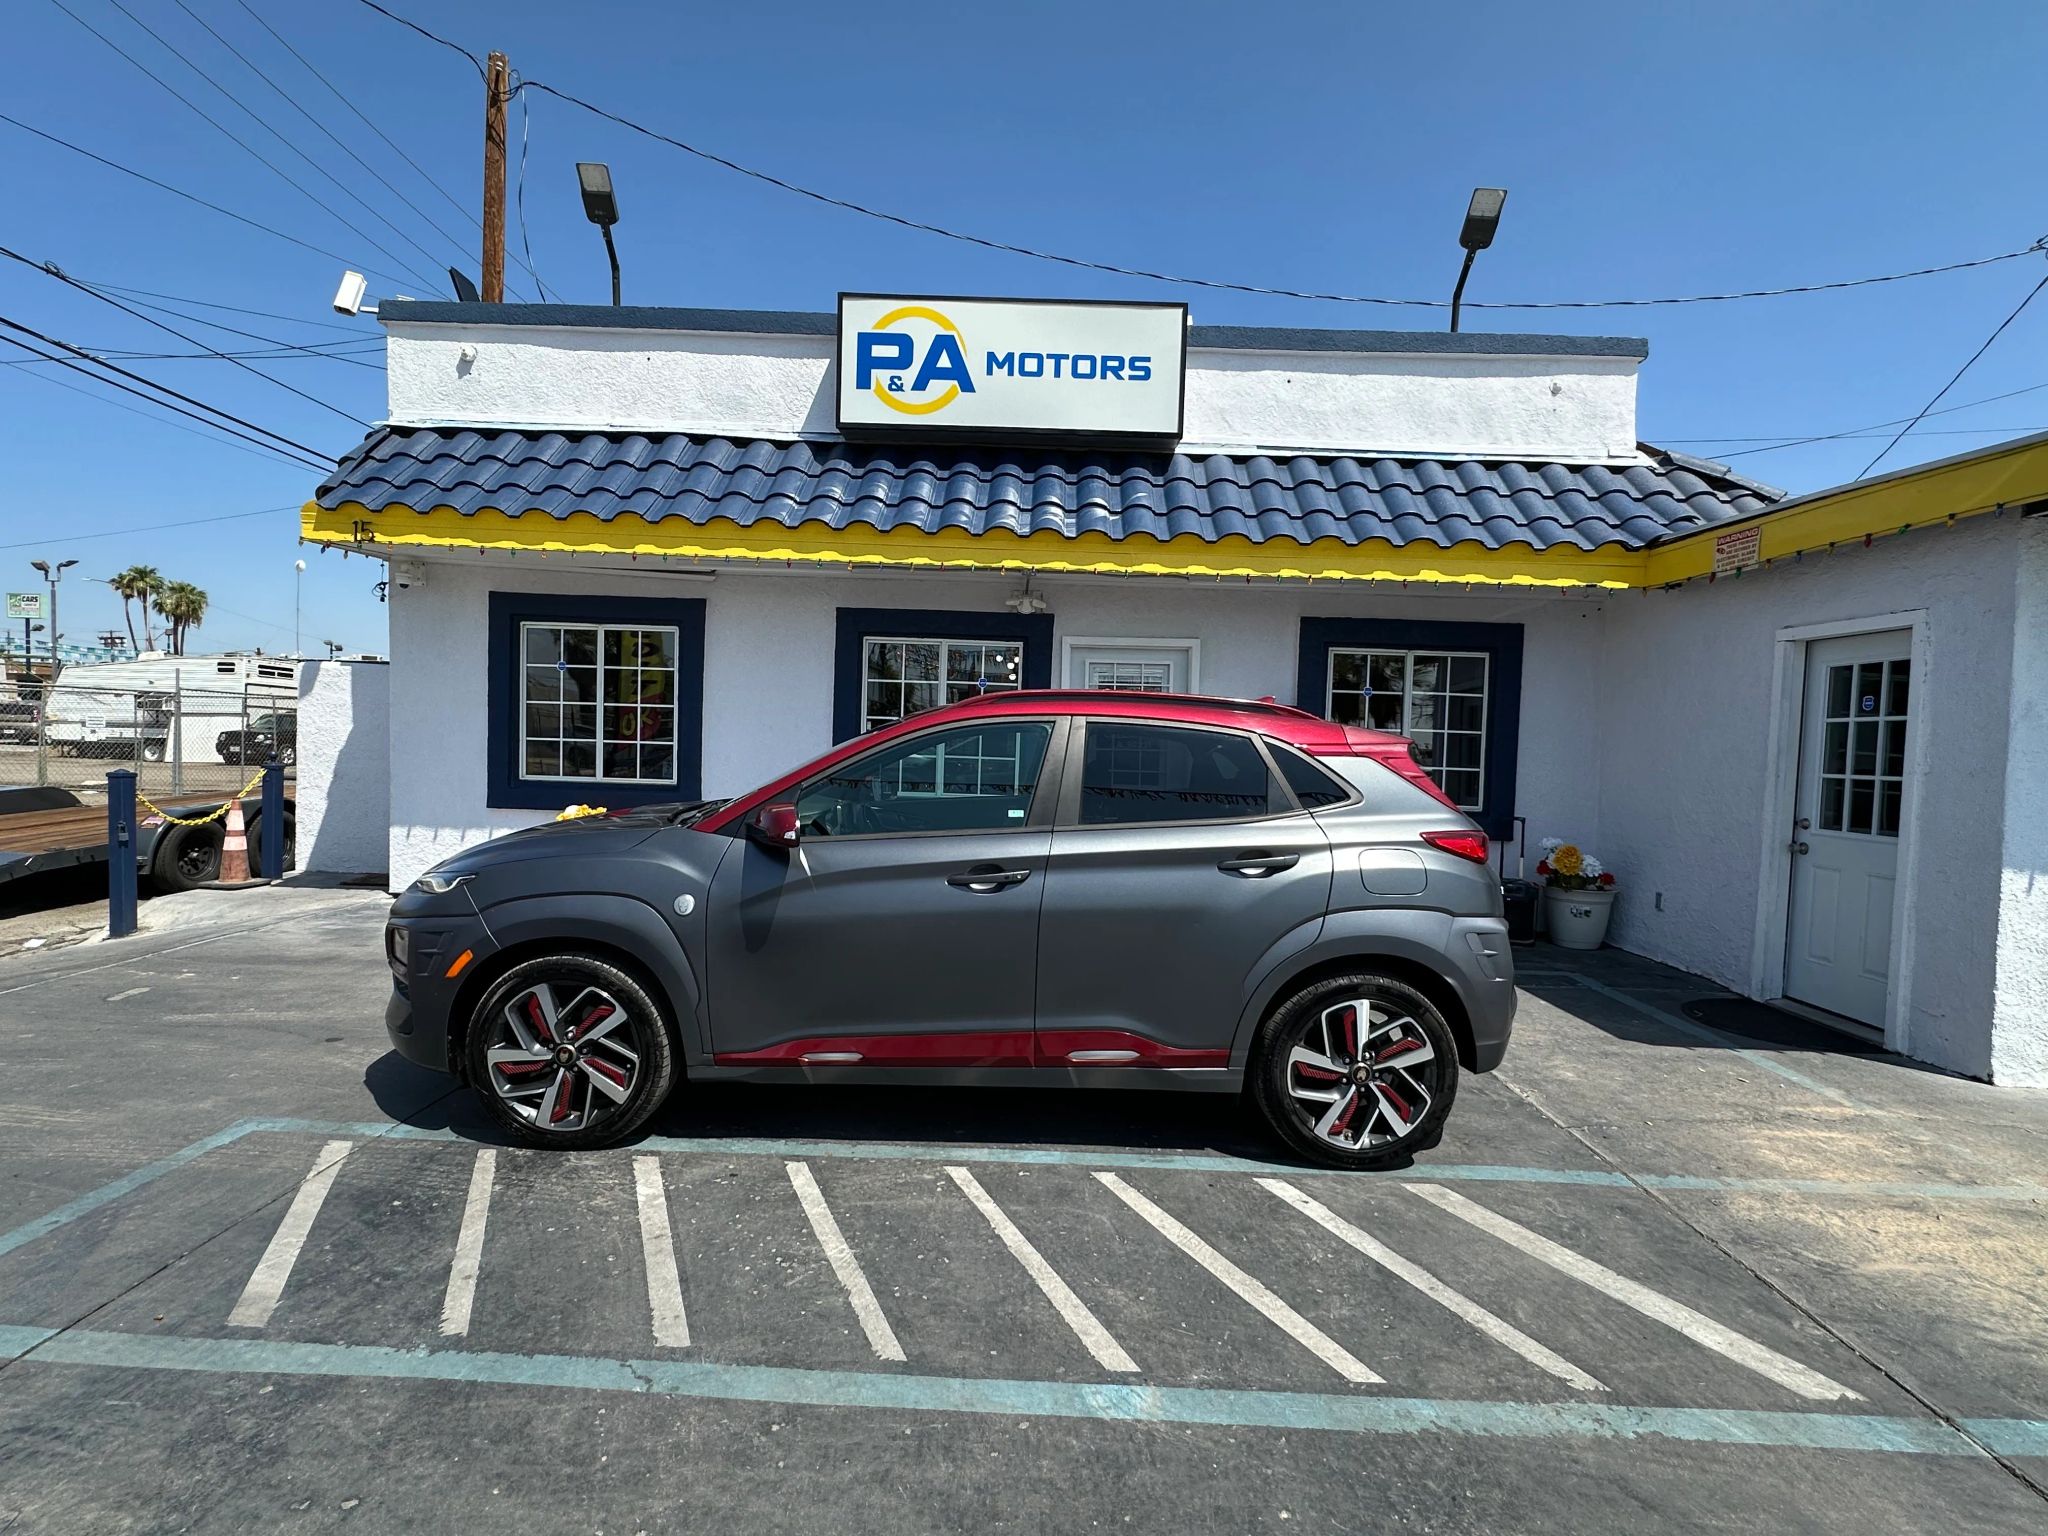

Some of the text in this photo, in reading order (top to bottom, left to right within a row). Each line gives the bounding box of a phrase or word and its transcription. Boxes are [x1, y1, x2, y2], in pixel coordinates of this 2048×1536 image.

[986, 351, 1152, 381] MOTORS
[352, 520, 376, 542] 15
[1718, 528, 1759, 545] WARNING
[21, 595, 39, 603] CARS
